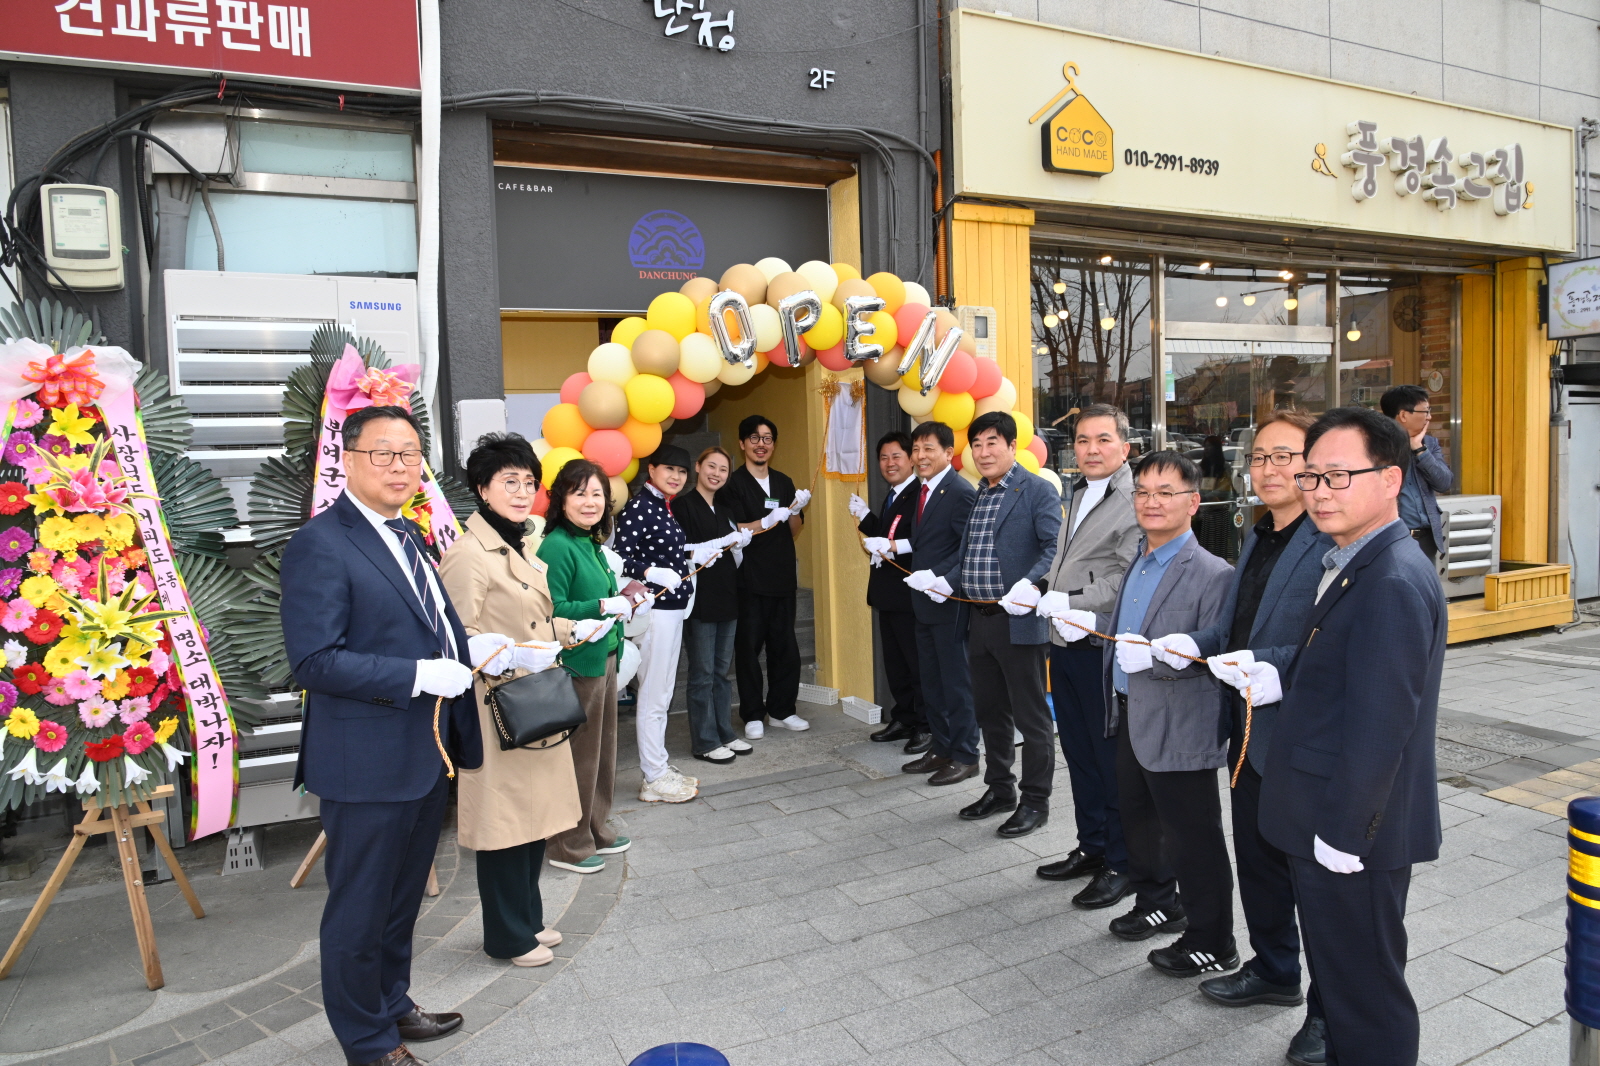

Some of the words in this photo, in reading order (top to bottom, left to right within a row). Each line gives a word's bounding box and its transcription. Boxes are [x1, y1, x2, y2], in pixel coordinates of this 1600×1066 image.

[809, 67, 836, 89] 2F
[1056, 145, 1081, 158] HAND
[1083, 149, 1108, 161] MADE
[1124, 148, 1220, 176] 010-2991-8939
[497, 182, 554, 193] CAFE&BAR
[638, 270, 698, 281] DANCHUNG
[349, 300, 402, 311] SAMSUNG
[708, 288, 964, 396] OPEN
[319, 418, 347, 488] 부여군
[174, 629, 207, 667] 명소
[188, 673, 232, 769] 대박나자!
